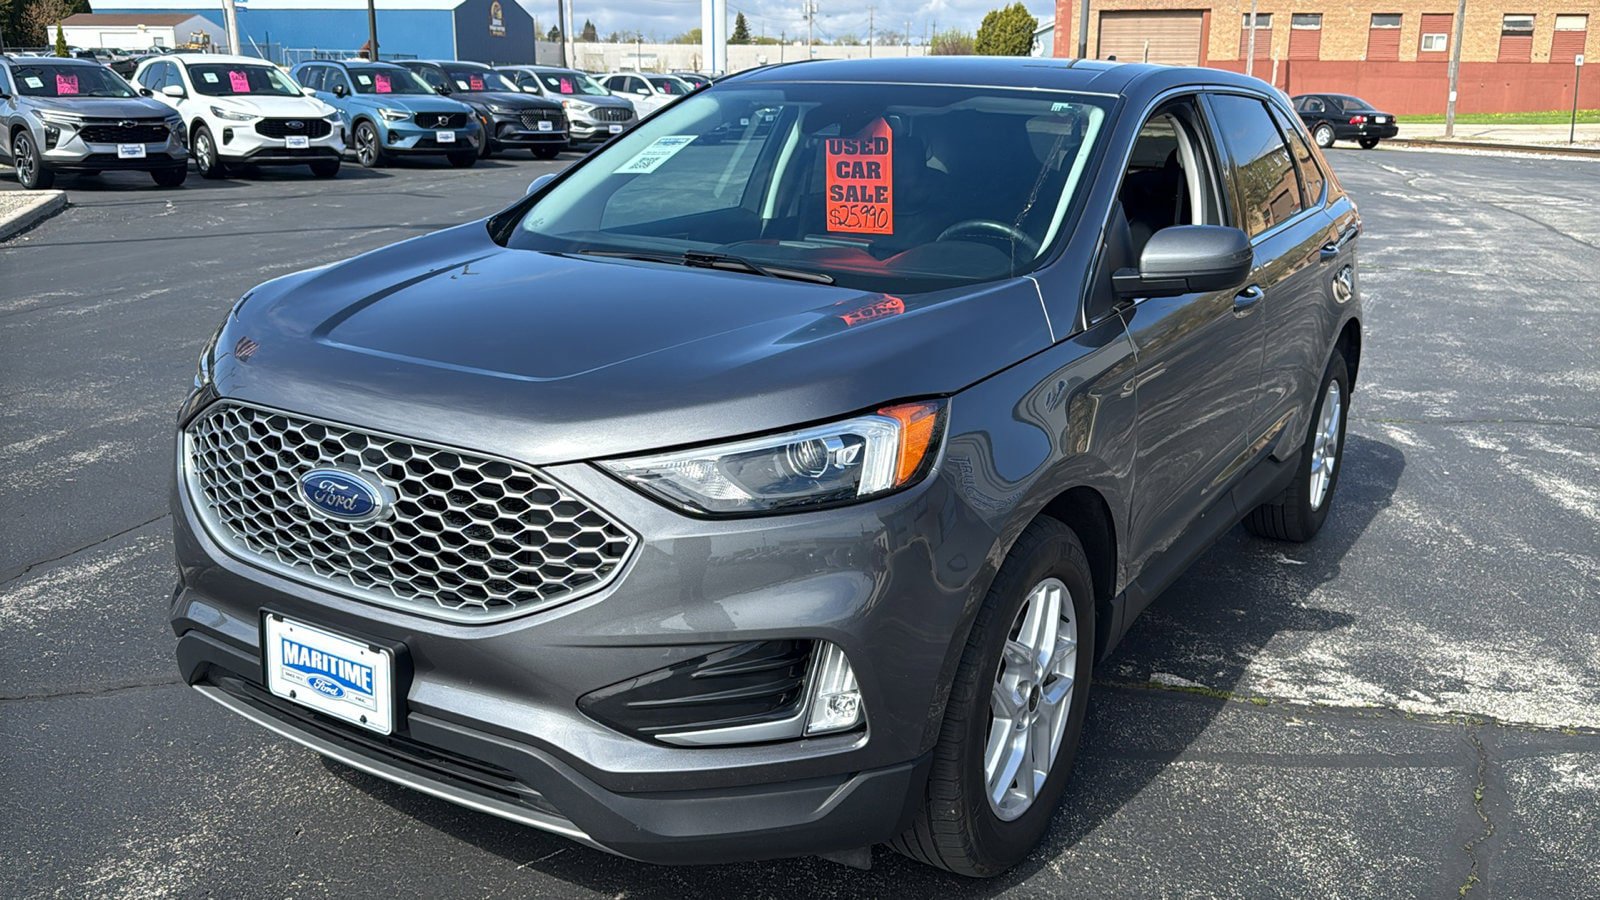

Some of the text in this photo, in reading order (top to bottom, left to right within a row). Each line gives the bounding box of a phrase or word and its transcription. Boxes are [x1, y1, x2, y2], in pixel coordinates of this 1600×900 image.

[829, 137, 889, 155] USED
[836, 161, 881, 179] CAR
[830, 185, 888, 203] SALE
[829, 204, 889, 229] $25,990
[314, 479, 358, 511] Ford
[283, 640, 372, 693] MARITIME
[313, 677, 339, 696] Ford
